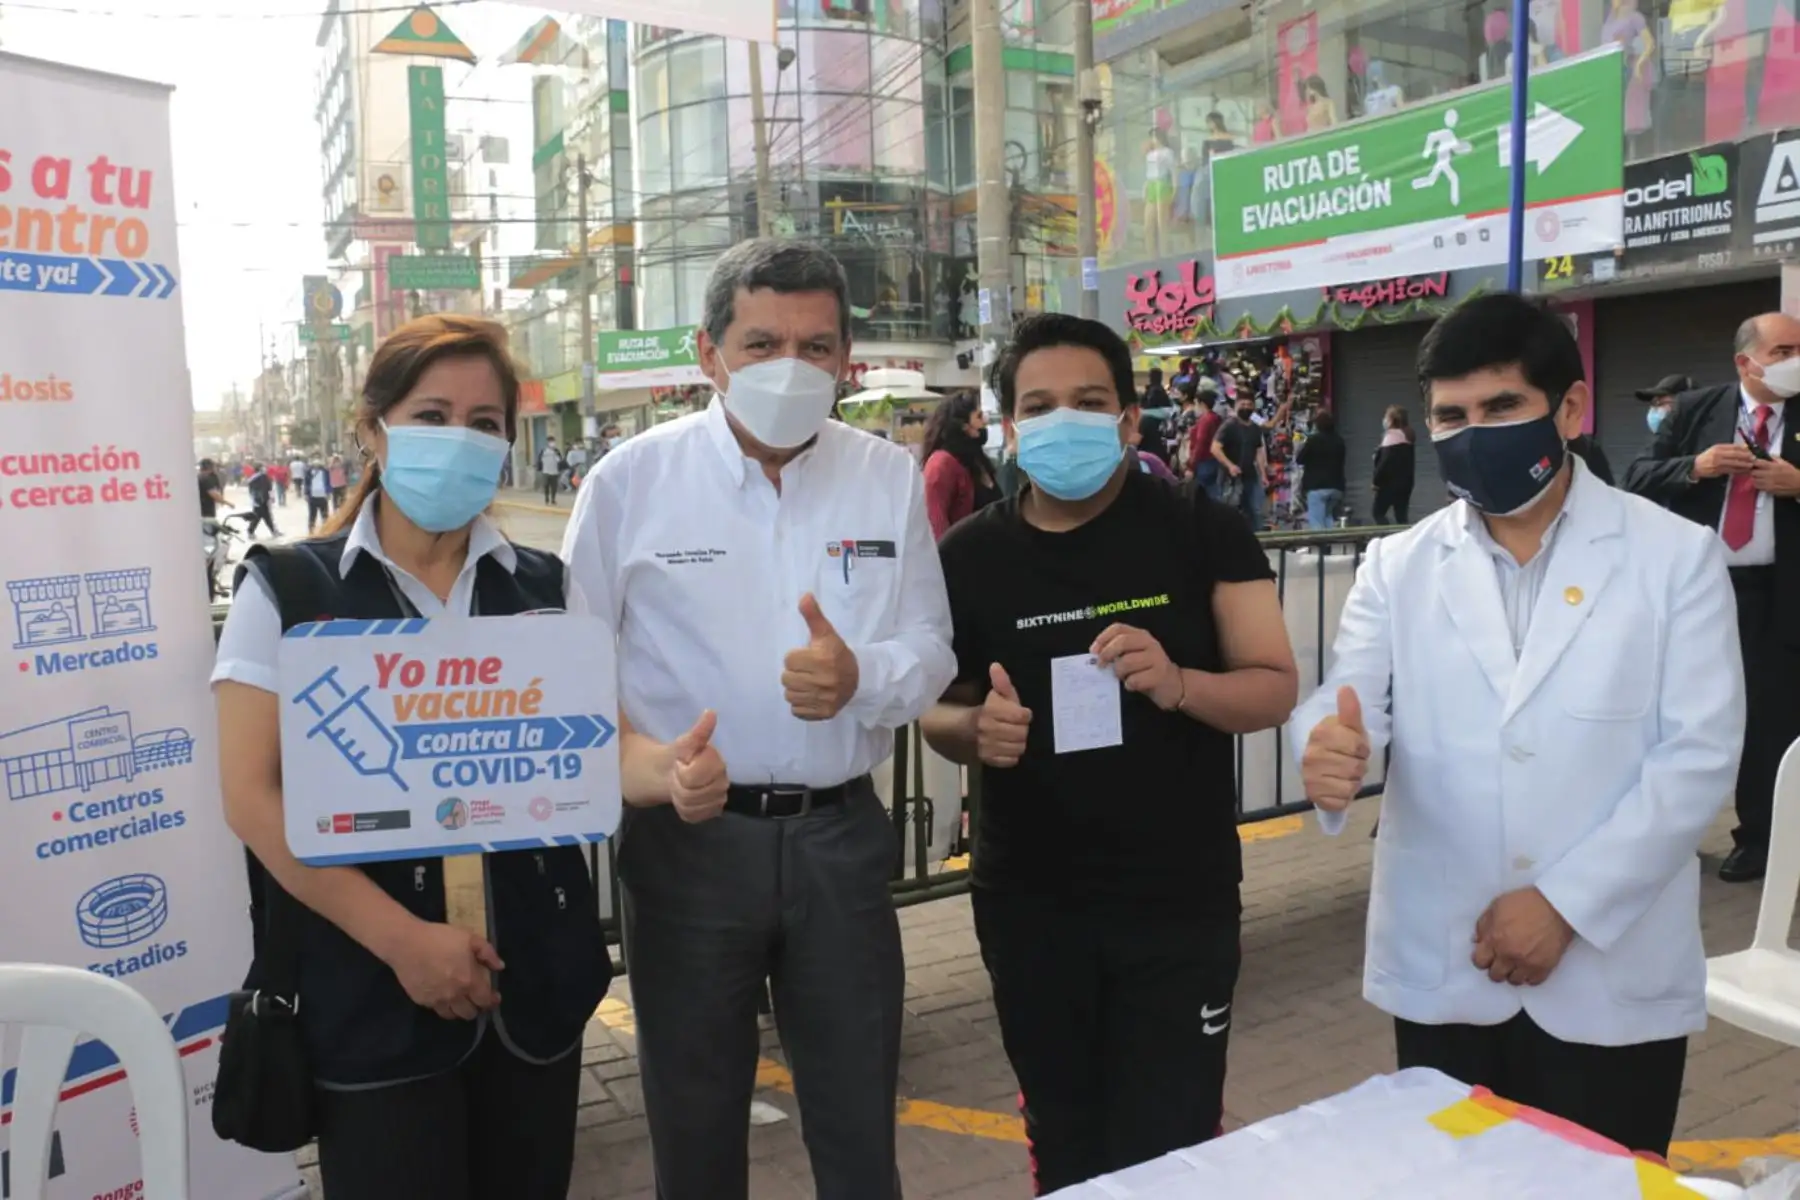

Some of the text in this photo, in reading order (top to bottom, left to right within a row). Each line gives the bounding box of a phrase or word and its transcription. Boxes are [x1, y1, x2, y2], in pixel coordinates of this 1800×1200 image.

[31, 154, 71, 200] a
[87, 153, 153, 210] tu
[1263, 145, 1361, 193] RUTA DE
[1242, 173, 1392, 233] EVACUACIÓN
[36, 261, 79, 290] ya!
[1544, 253, 1573, 279] 24
[10, 484, 94, 508] cerca
[101, 477, 137, 502] de
[1016, 594, 1170, 629] SIXTYNINE WORLDWIDE
[35, 641, 158, 676] Mercados
[373, 653, 503, 689] Yo me
[392, 677, 544, 722] vacuné
[416, 722, 544, 755] contra la
[432, 753, 582, 788] COVID-19
[68, 788, 164, 823] Centros
[36, 810, 186, 859] comerciales
